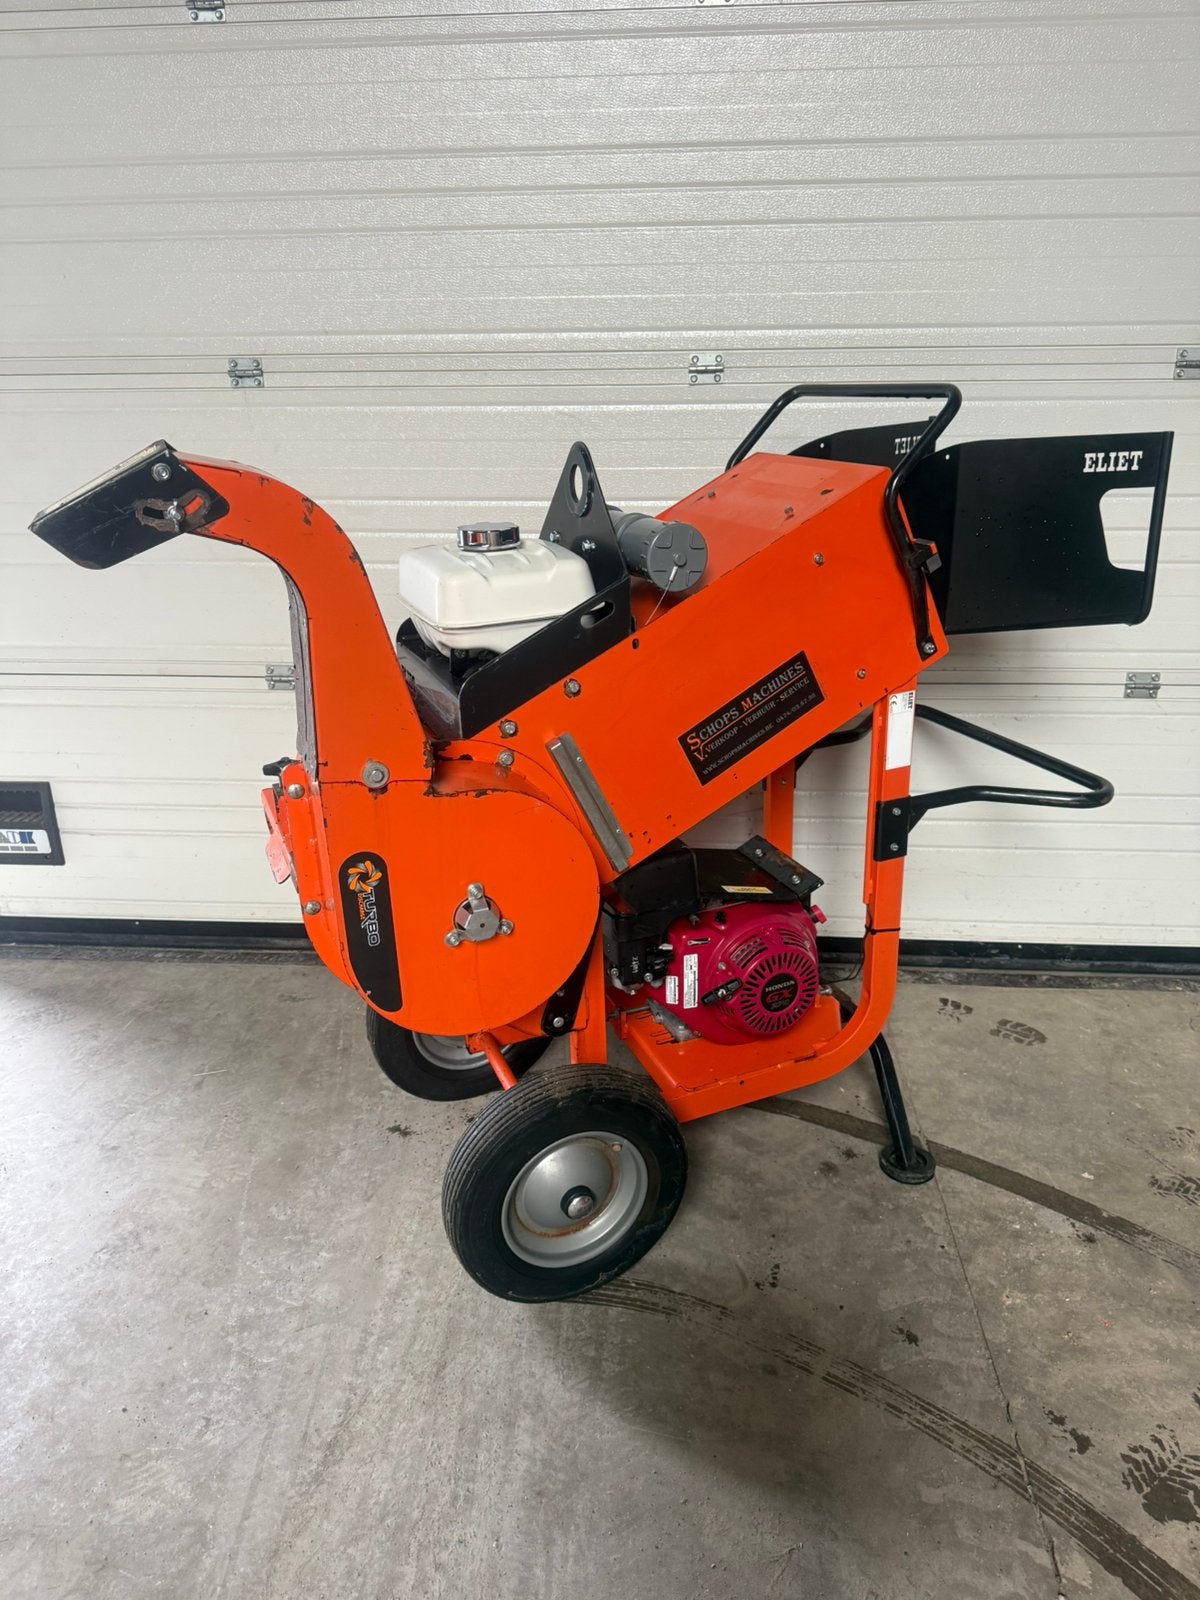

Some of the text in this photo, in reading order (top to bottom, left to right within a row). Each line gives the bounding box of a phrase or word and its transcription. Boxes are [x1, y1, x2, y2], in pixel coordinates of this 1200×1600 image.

[1083, 451, 1143, 472] ELIET
[686, 661, 805, 751] SCHOPS MACHINES
[705, 725, 739, 753] VERKOOP
[742, 699, 776, 727] VERHUUR
[779, 676, 810, 702] SERVICE
[361, 887, 381, 947] TURBO
[765, 980, 795, 992] HONDA
